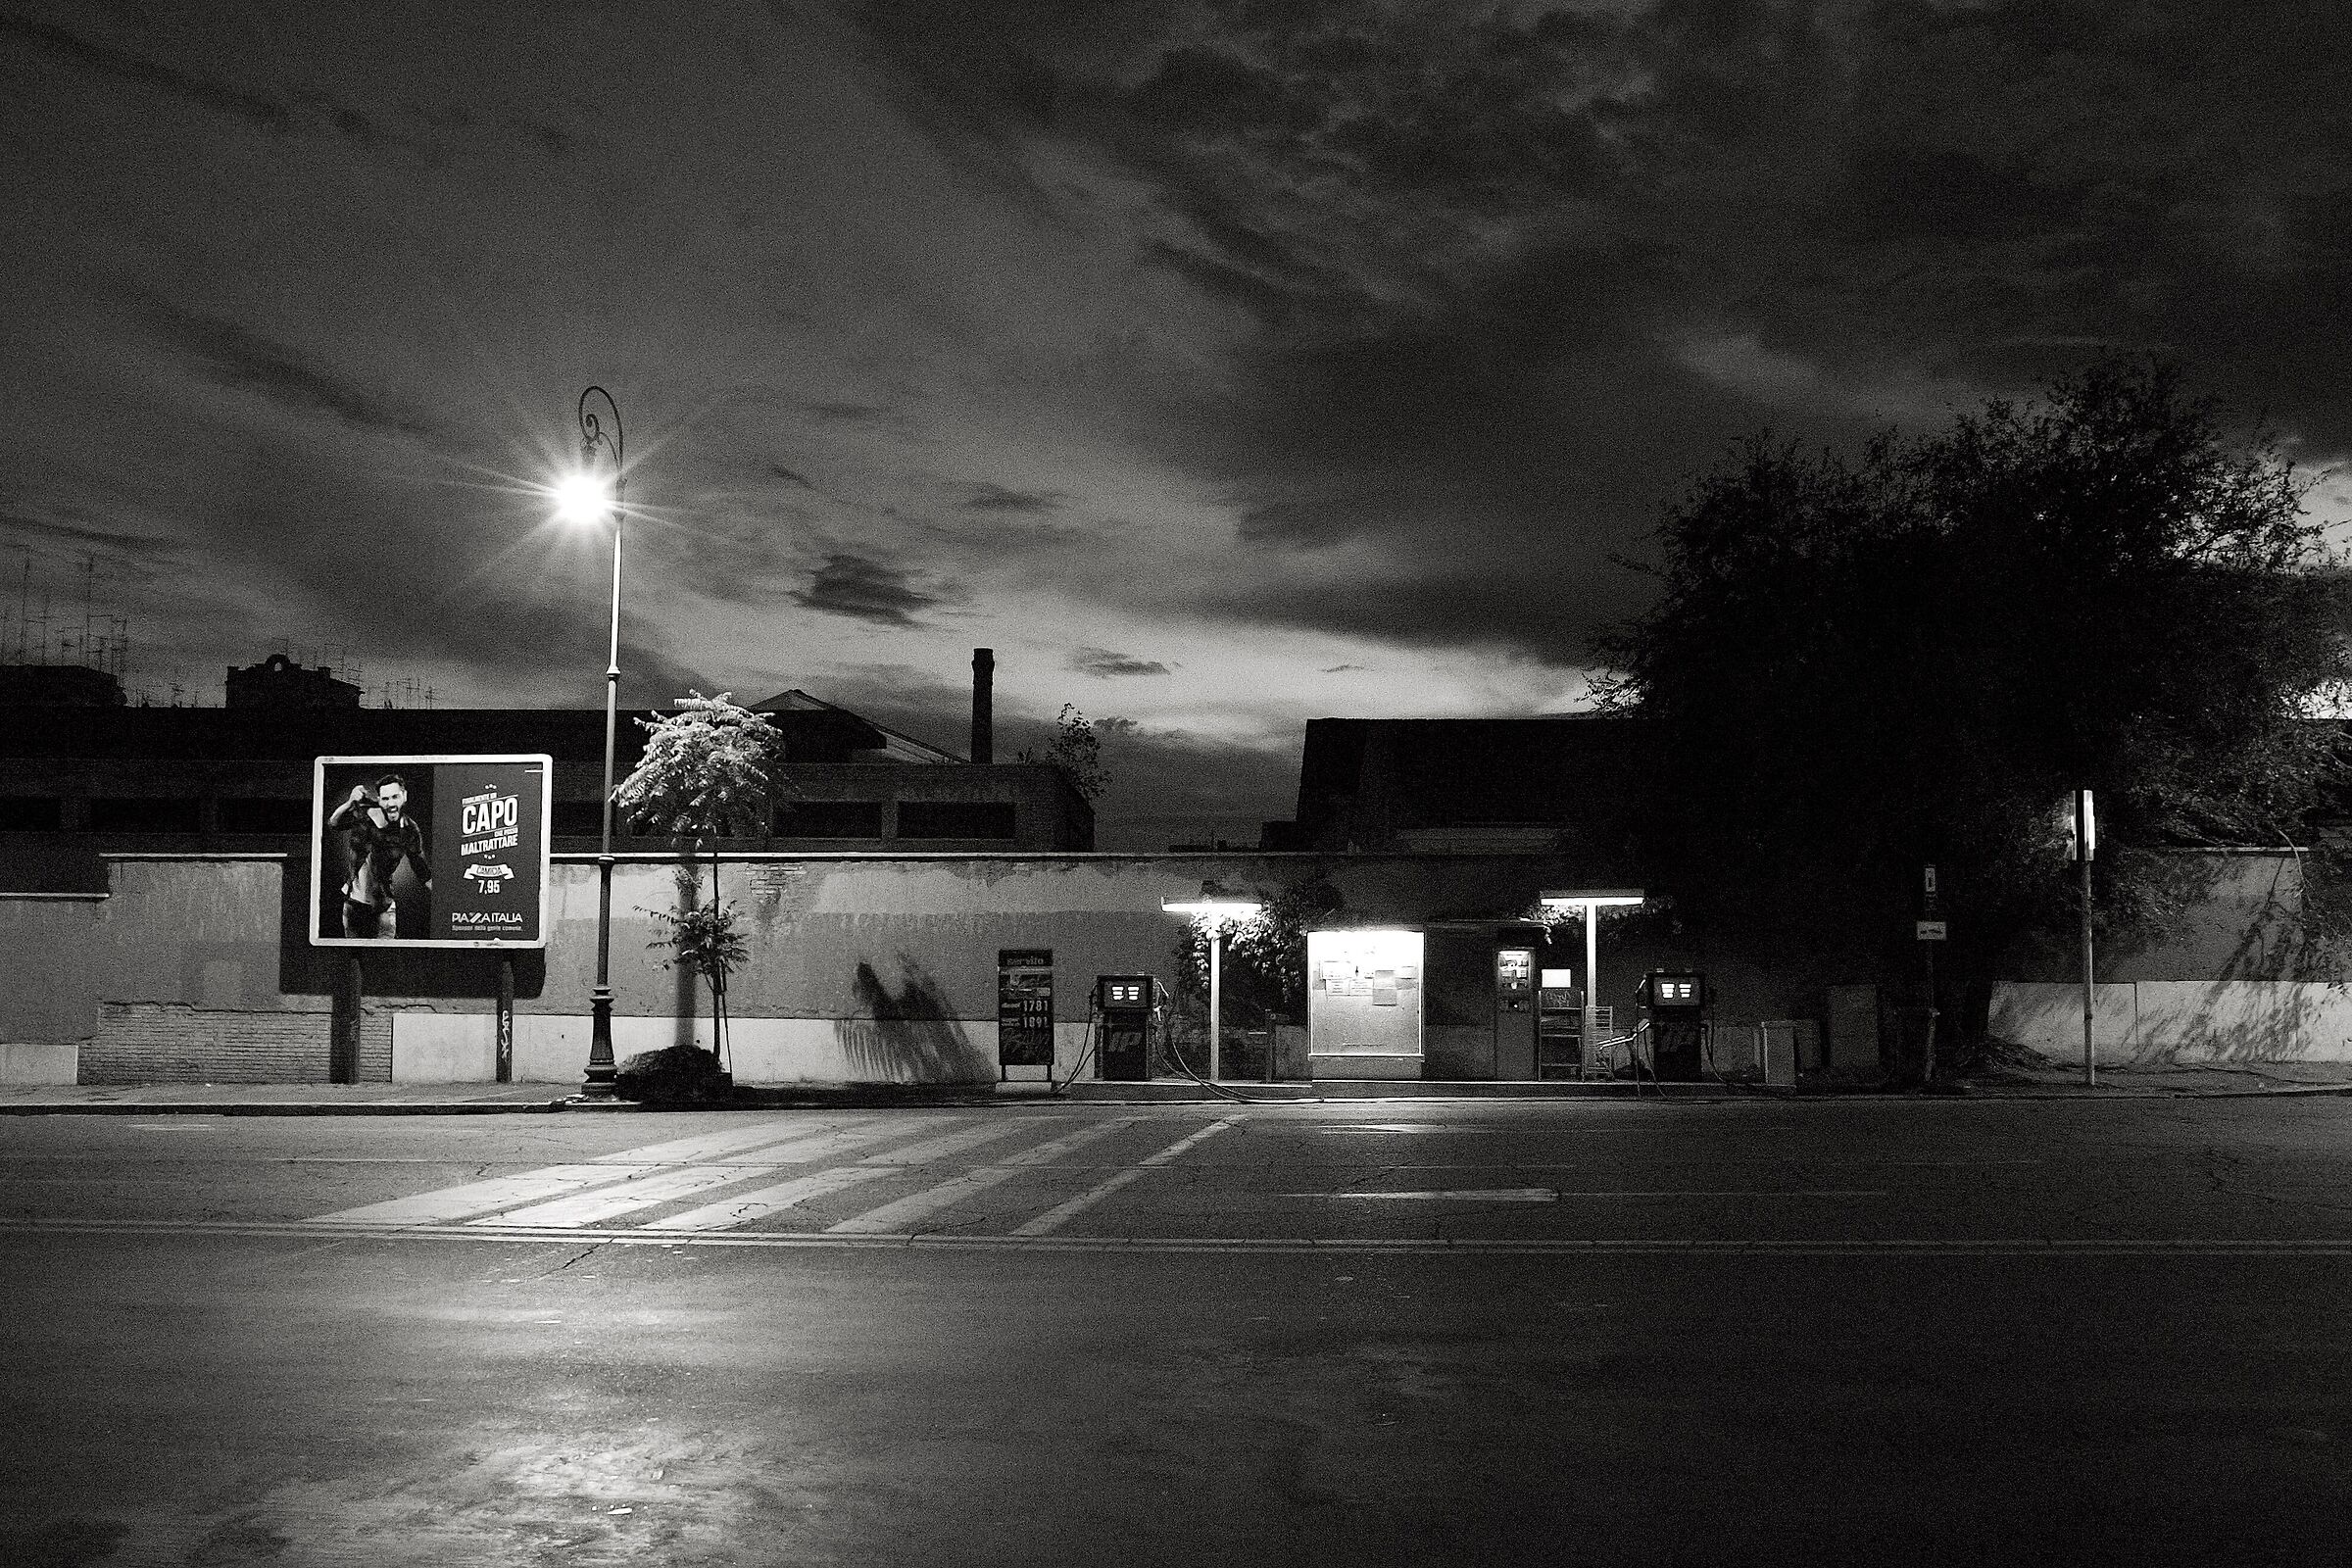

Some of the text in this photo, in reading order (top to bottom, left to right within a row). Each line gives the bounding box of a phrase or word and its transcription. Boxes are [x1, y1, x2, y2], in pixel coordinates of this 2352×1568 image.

[462, 797, 518, 834] CAPO
[461, 833, 518, 856] MALTRATTARE
[477, 879, 501, 895] 7,95
[491, 912, 523, 923] ITALIA
